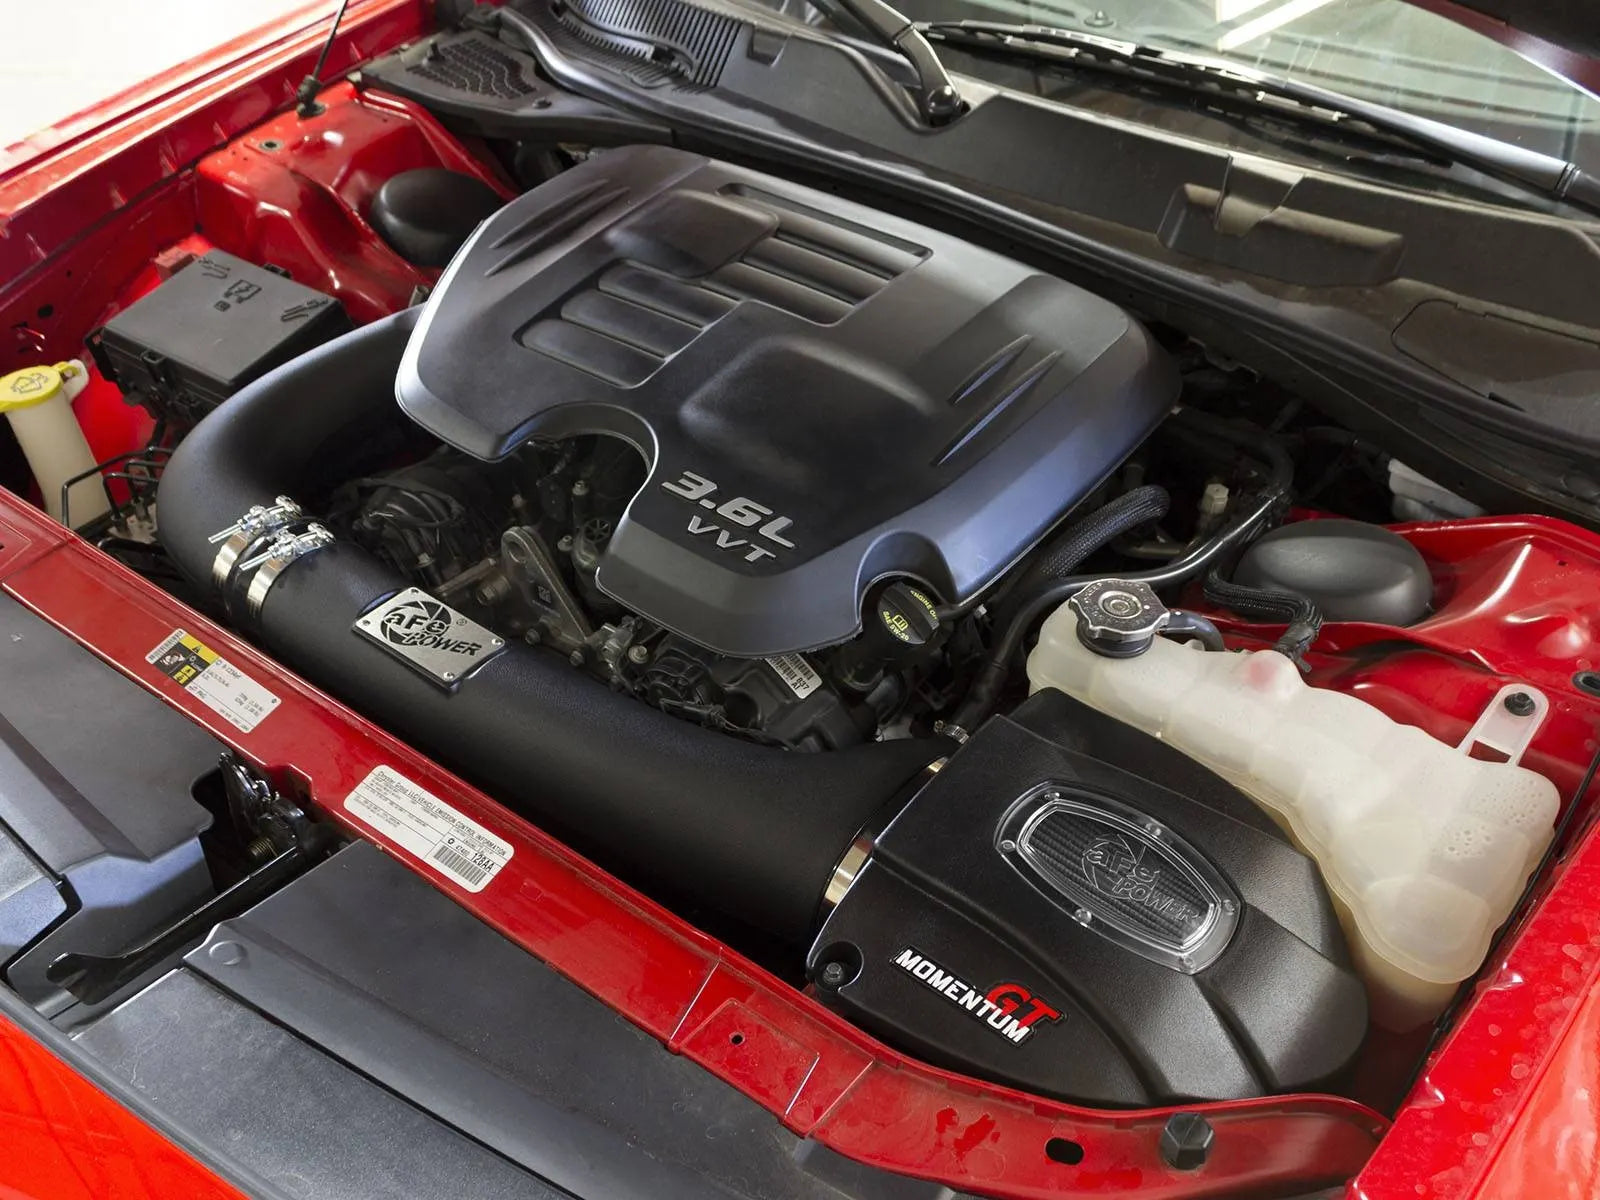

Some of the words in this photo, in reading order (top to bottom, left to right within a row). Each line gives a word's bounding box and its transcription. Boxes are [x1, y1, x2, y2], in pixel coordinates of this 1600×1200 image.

[661, 470, 796, 549] 3.6L
[687, 514, 777, 562] VVT
[384, 611, 447, 634] aFe
[403, 630, 483, 657] POWER
[1084, 849, 1156, 882] aFe
[1111, 874, 1201, 921] POWER
[895, 949, 1031, 1043] MOMENTUM
[986, 983, 1062, 1029] GT
